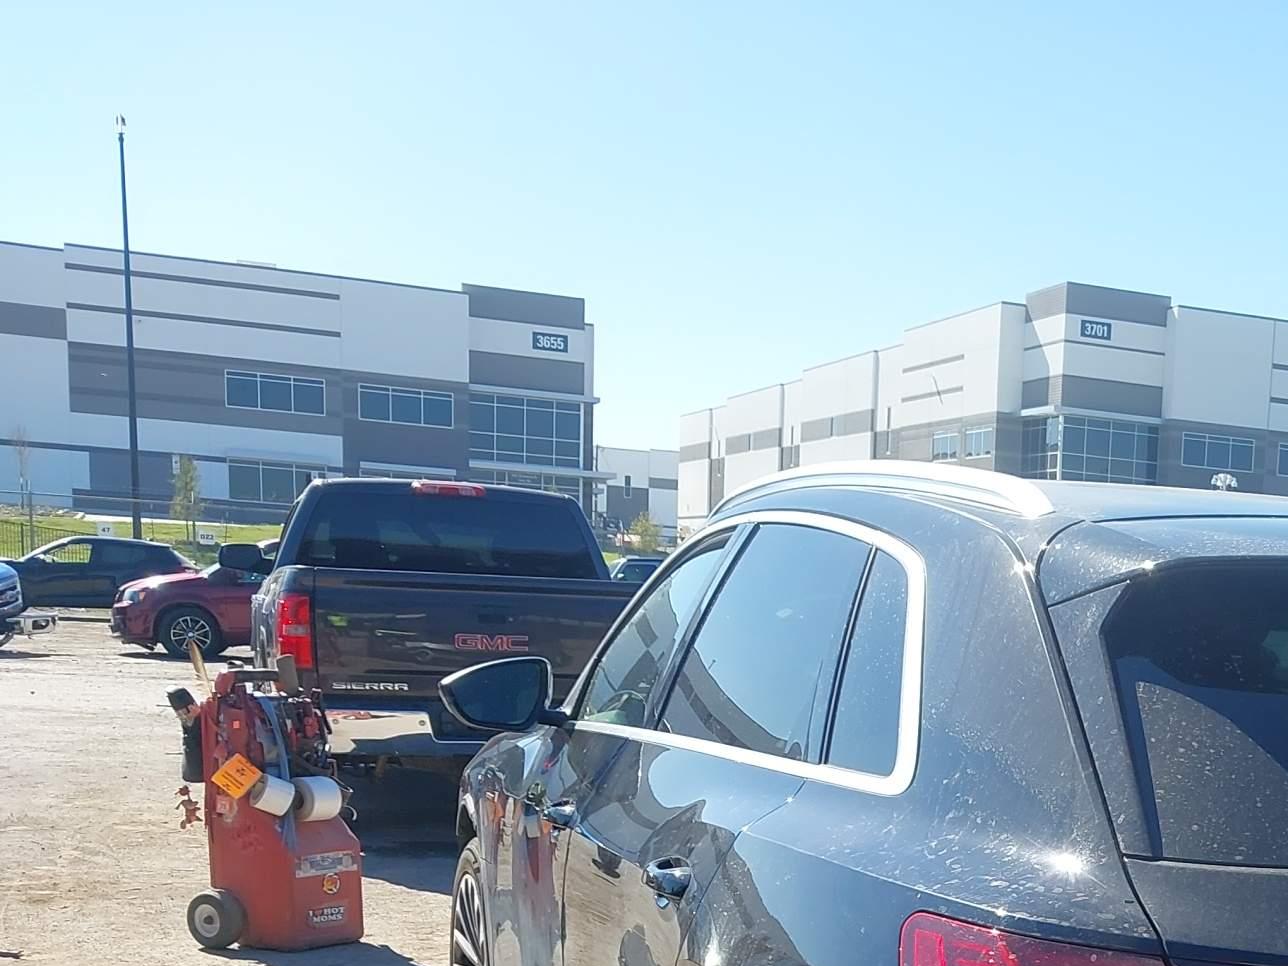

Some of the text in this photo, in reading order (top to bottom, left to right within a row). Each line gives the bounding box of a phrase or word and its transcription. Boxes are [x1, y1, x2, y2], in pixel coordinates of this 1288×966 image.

[1084, 322, 1108, 338] 3701
[536, 335, 565, 350] 3655
[454, 633, 529, 652] GMC
[331, 681, 409, 691] SIERRA
